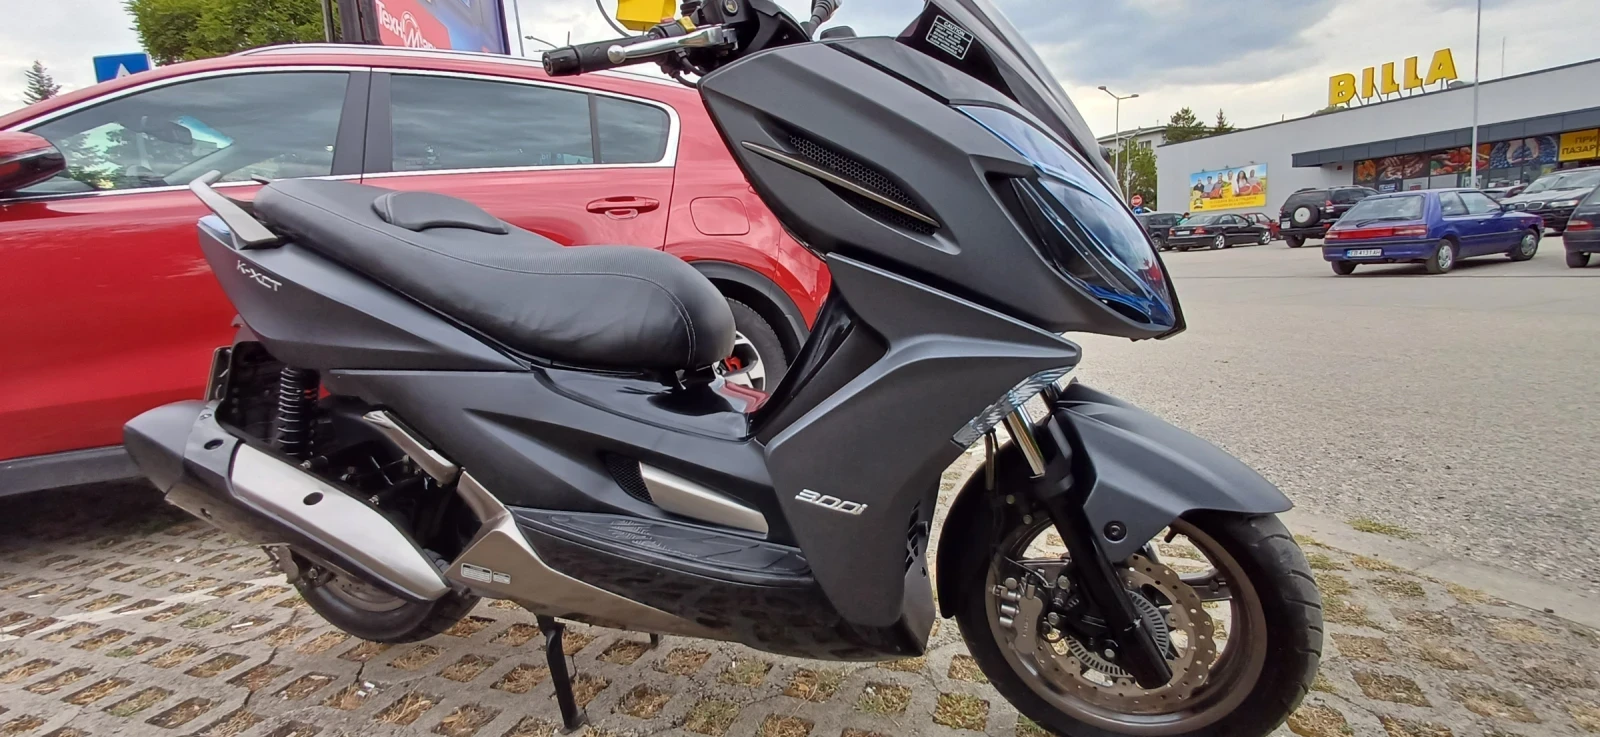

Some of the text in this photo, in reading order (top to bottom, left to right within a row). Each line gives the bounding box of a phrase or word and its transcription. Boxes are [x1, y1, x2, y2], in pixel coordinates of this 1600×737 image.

[1328, 48, 1458, 106] BILLA
[236, 260, 282, 291] K-XCT
[795, 488, 868, 515] 300i
